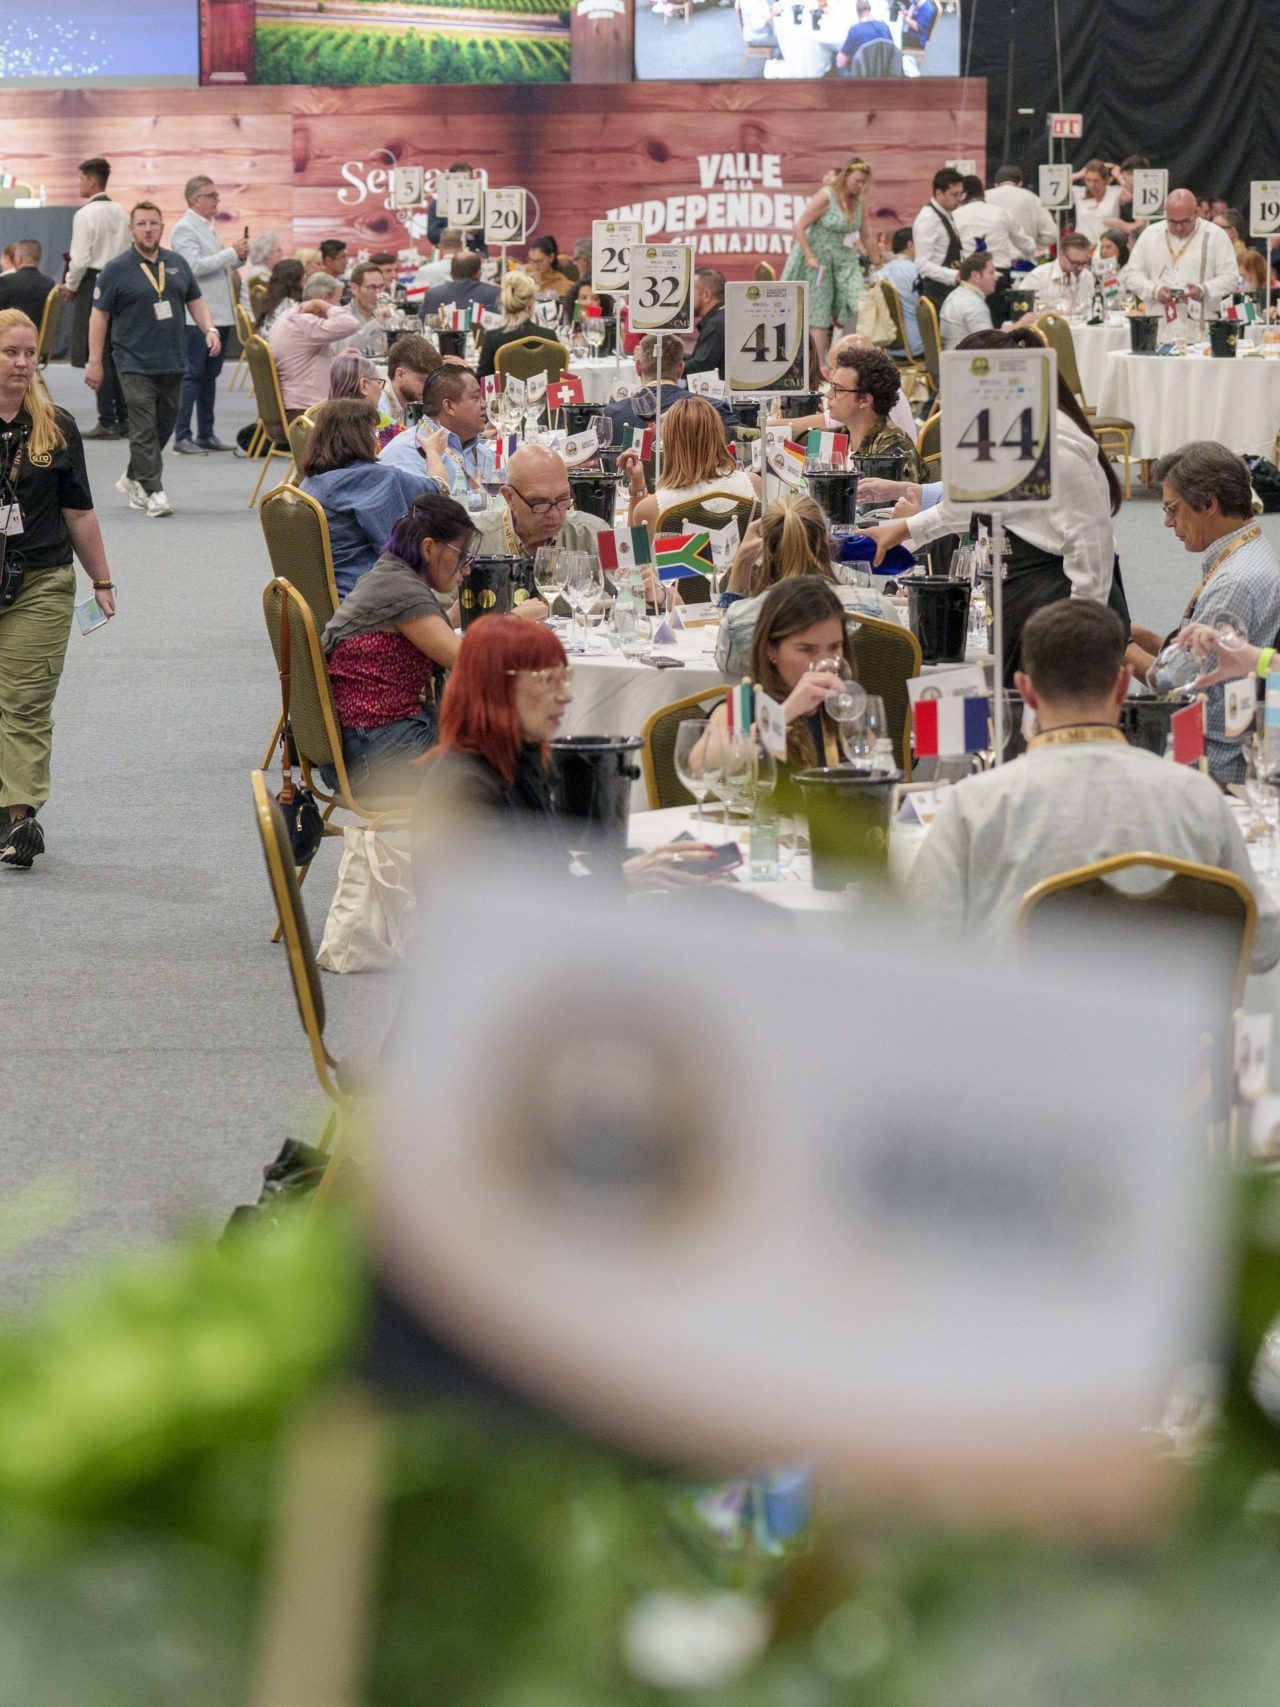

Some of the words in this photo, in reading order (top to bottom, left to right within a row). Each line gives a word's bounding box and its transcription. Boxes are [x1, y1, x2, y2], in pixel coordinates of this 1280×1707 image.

[697, 152, 783, 189] VALLE
[337, 161, 489, 206] Seaa
[404, 182, 414, 196] 5
[723, 179, 737, 191] DE
[740, 179, 754, 191] LA
[1049, 182, 1060, 196] 7
[1141, 188, 1159, 205] 18
[456, 198, 475, 215] 17
[1261, 201, 1280, 221] 19
[491, 210, 518, 229] 20
[639, 276, 680, 308] 32
[740, 323, 789, 362] 41
[956, 408, 1039, 462] 44
